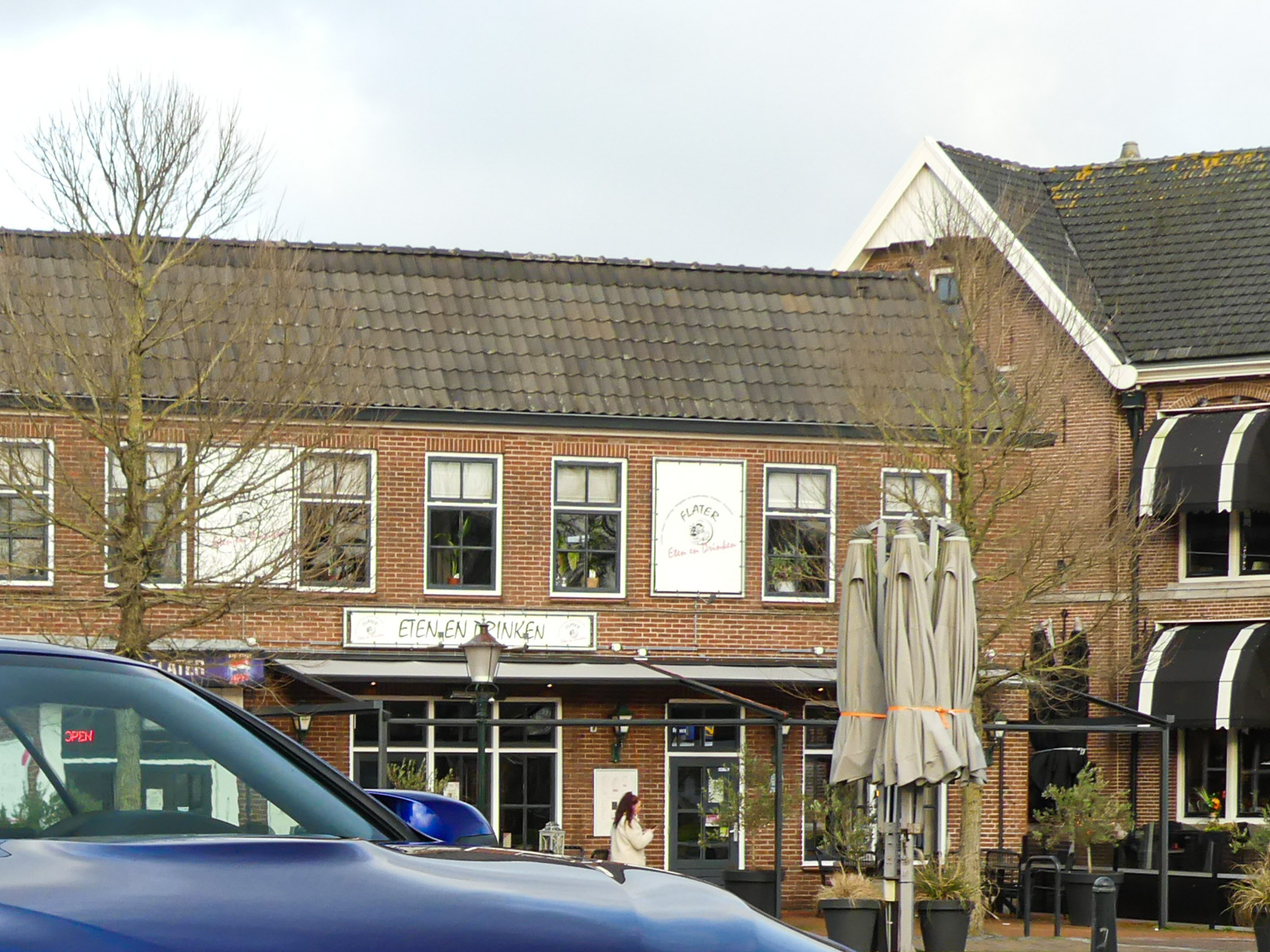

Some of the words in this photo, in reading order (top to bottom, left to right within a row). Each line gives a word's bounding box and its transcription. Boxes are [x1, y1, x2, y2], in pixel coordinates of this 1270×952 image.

[680, 504, 720, 523] FLATER
[668, 547, 687, 559] Eten
[689, 547, 700, 555] en
[701, 539, 737, 554] Drinken
[398, 618, 440, 639] ETEN
[445, 619, 468, 639] EN
[149, 658, 205, 676] LATER
[65, 729, 94, 743] OPEN
